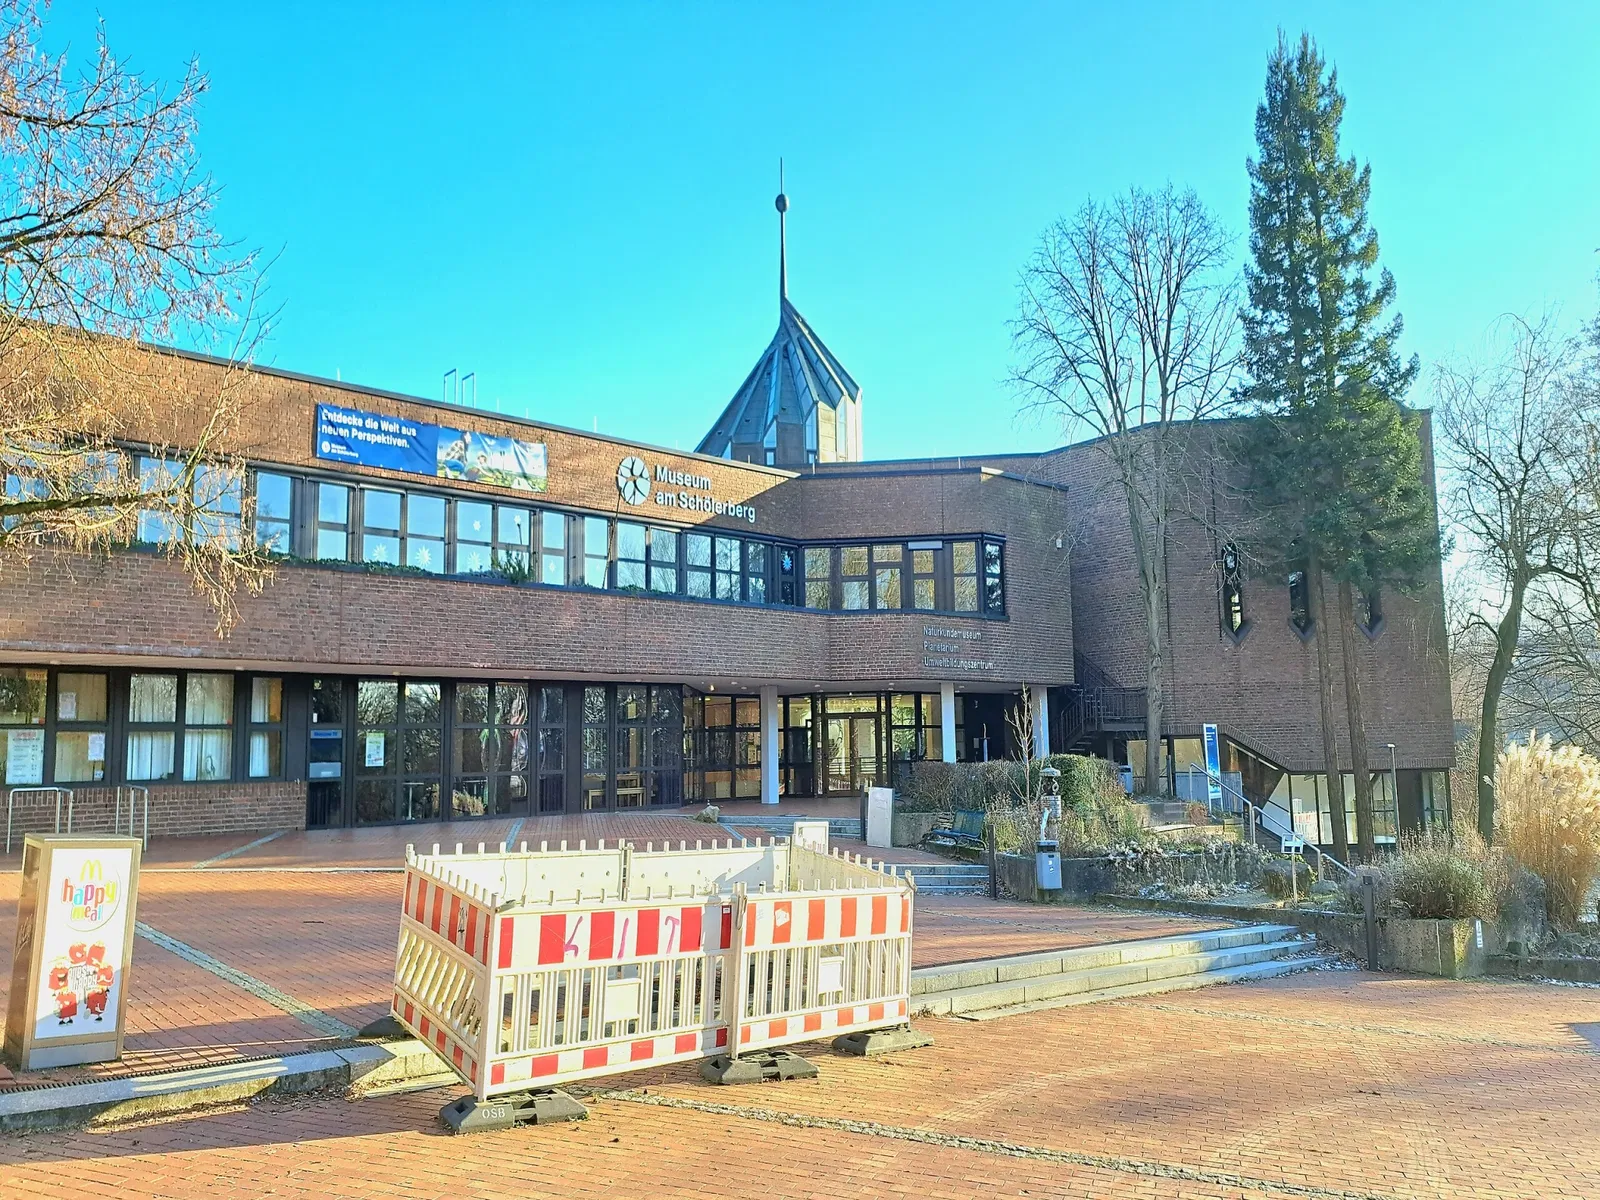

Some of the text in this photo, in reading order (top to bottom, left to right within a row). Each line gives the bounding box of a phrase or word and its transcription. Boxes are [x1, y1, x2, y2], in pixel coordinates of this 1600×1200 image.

[321, 408, 417, 437] Entdecke die Welt aus
[321, 424, 410, 448] neuen Perspektiven.
[656, 464, 712, 491] Museum
[656, 491, 756, 523] am Schölerberg
[62, 878, 117, 908] happy
[72, 905, 103, 921] meal
[482, 1107, 506, 1119] OSB
